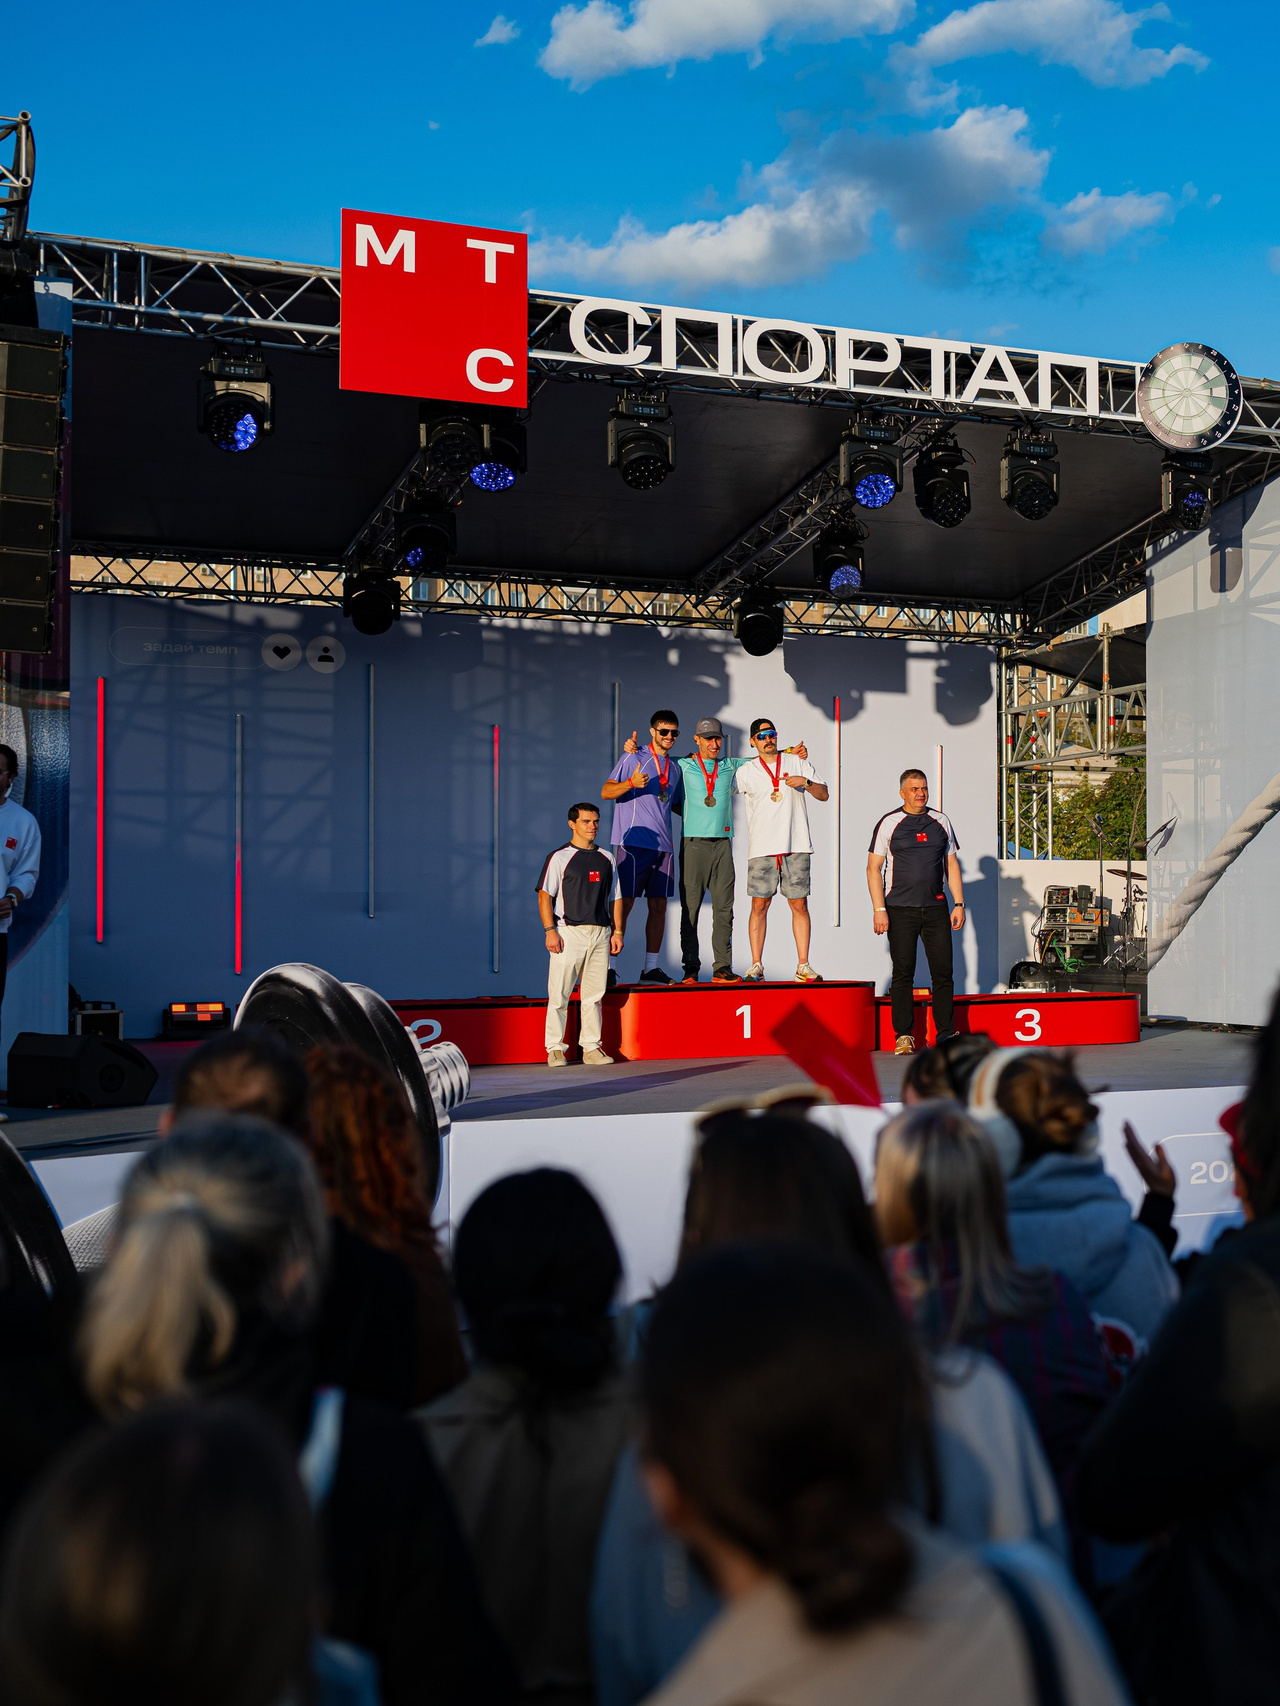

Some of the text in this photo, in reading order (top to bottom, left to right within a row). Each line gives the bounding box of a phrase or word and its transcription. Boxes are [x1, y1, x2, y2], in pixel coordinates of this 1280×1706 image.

[355, 223, 515, 284] М Т
[465, 347, 515, 393] С
[569, 299, 1100, 417] СПОРТАП
[142, 641, 239, 655] задай темп
[735, 1004, 751, 1039] 1
[1014, 1008, 1042, 1041] 3
